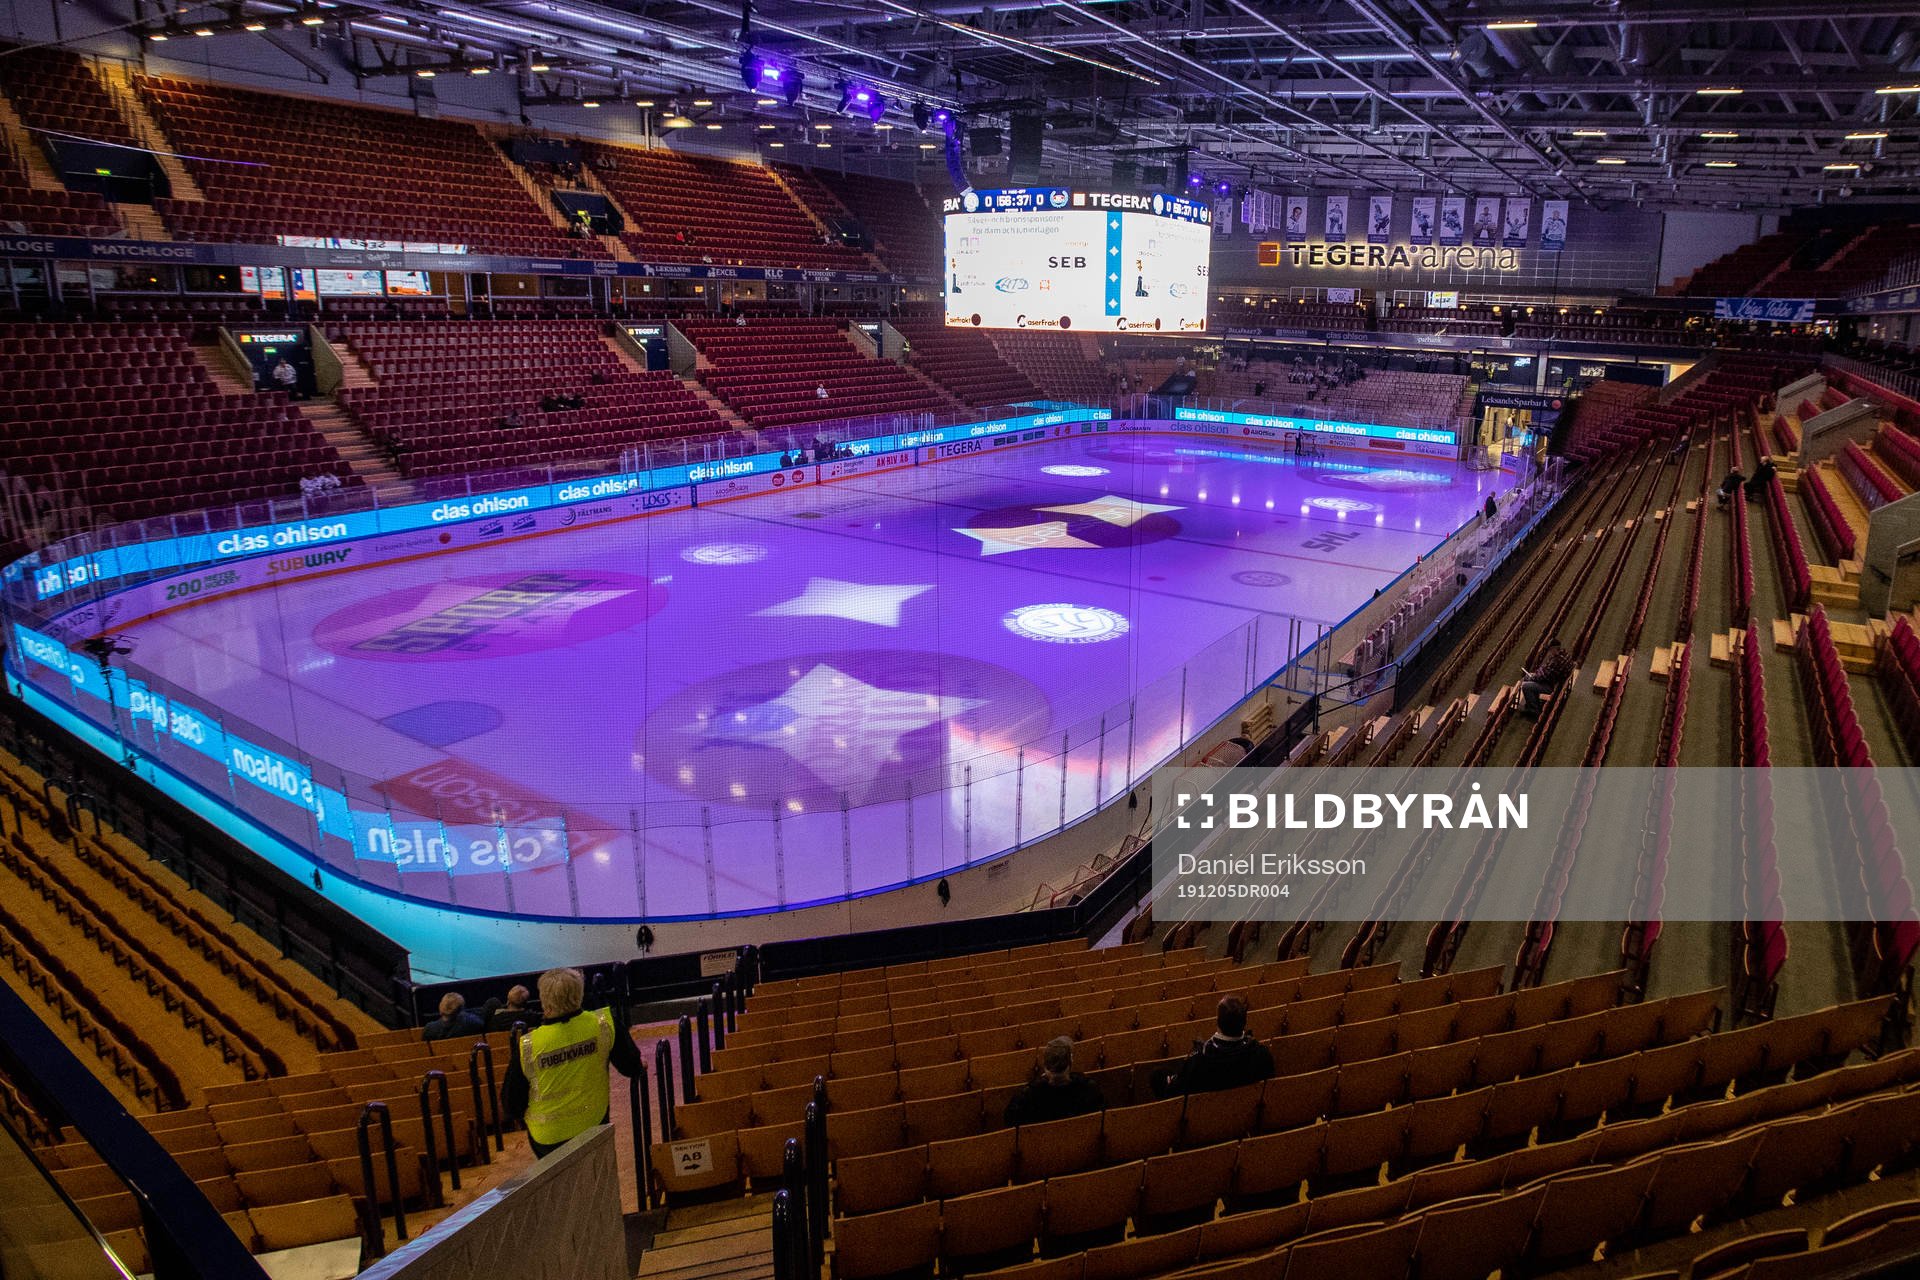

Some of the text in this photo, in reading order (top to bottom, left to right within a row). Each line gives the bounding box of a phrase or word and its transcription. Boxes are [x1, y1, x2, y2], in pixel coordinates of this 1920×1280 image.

[985, 196, 993, 206] 0
[1036, 194, 1044, 205] 0
[92, 244, 194, 258] MATCHLOGE
[1421, 246, 1517, 270] arena
[1048, 256, 1087, 268] SEB
[716, 268, 737, 276] EXCEL
[764, 269, 784, 277] KLC
[1343, 332, 1368, 341] ohlson
[1033, 416, 1044, 426] clas
[1180, 409, 1225, 423] clas ohlson
[1245, 416, 1294, 429] clas ohlson
[970, 426, 985, 437] clas
[1170, 421, 1229, 434] clas ohlson
[1315, 422, 1367, 436] clas ohlson
[1396, 430, 1451, 443] clas ohlson
[689, 463, 715, 481] clas
[558, 485, 591, 501] clas
[642, 492, 672, 509] LOGS
[432, 495, 529, 521] clas ohlson
[217, 523, 348, 554] clas ohlson
[1301, 530, 1361, 553] SHL
[266, 548, 353, 575] SUBWAY
[166, 578, 202, 601] 200
[541, 1041, 597, 1069] PUBLIKVÄRD
